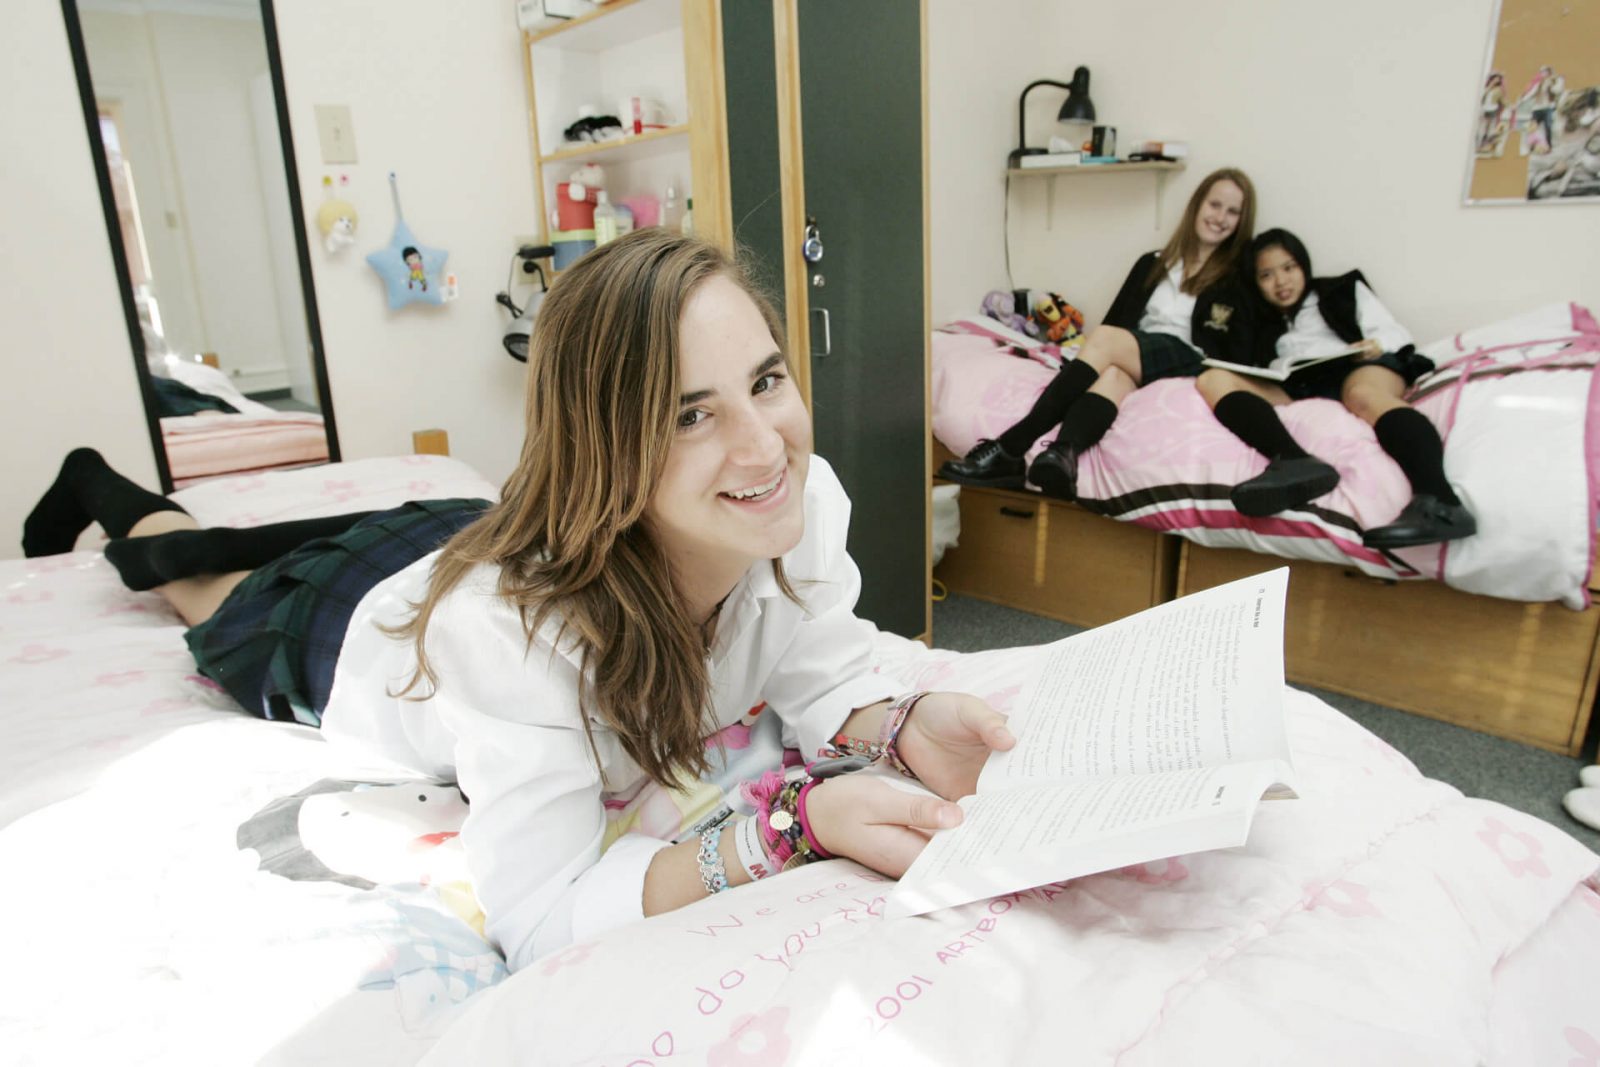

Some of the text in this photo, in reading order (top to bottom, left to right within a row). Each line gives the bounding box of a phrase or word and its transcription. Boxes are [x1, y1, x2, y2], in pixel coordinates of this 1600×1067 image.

[686, 882, 855, 937] We are
[696, 969, 745, 1015] do
[754, 921, 821, 972] you
